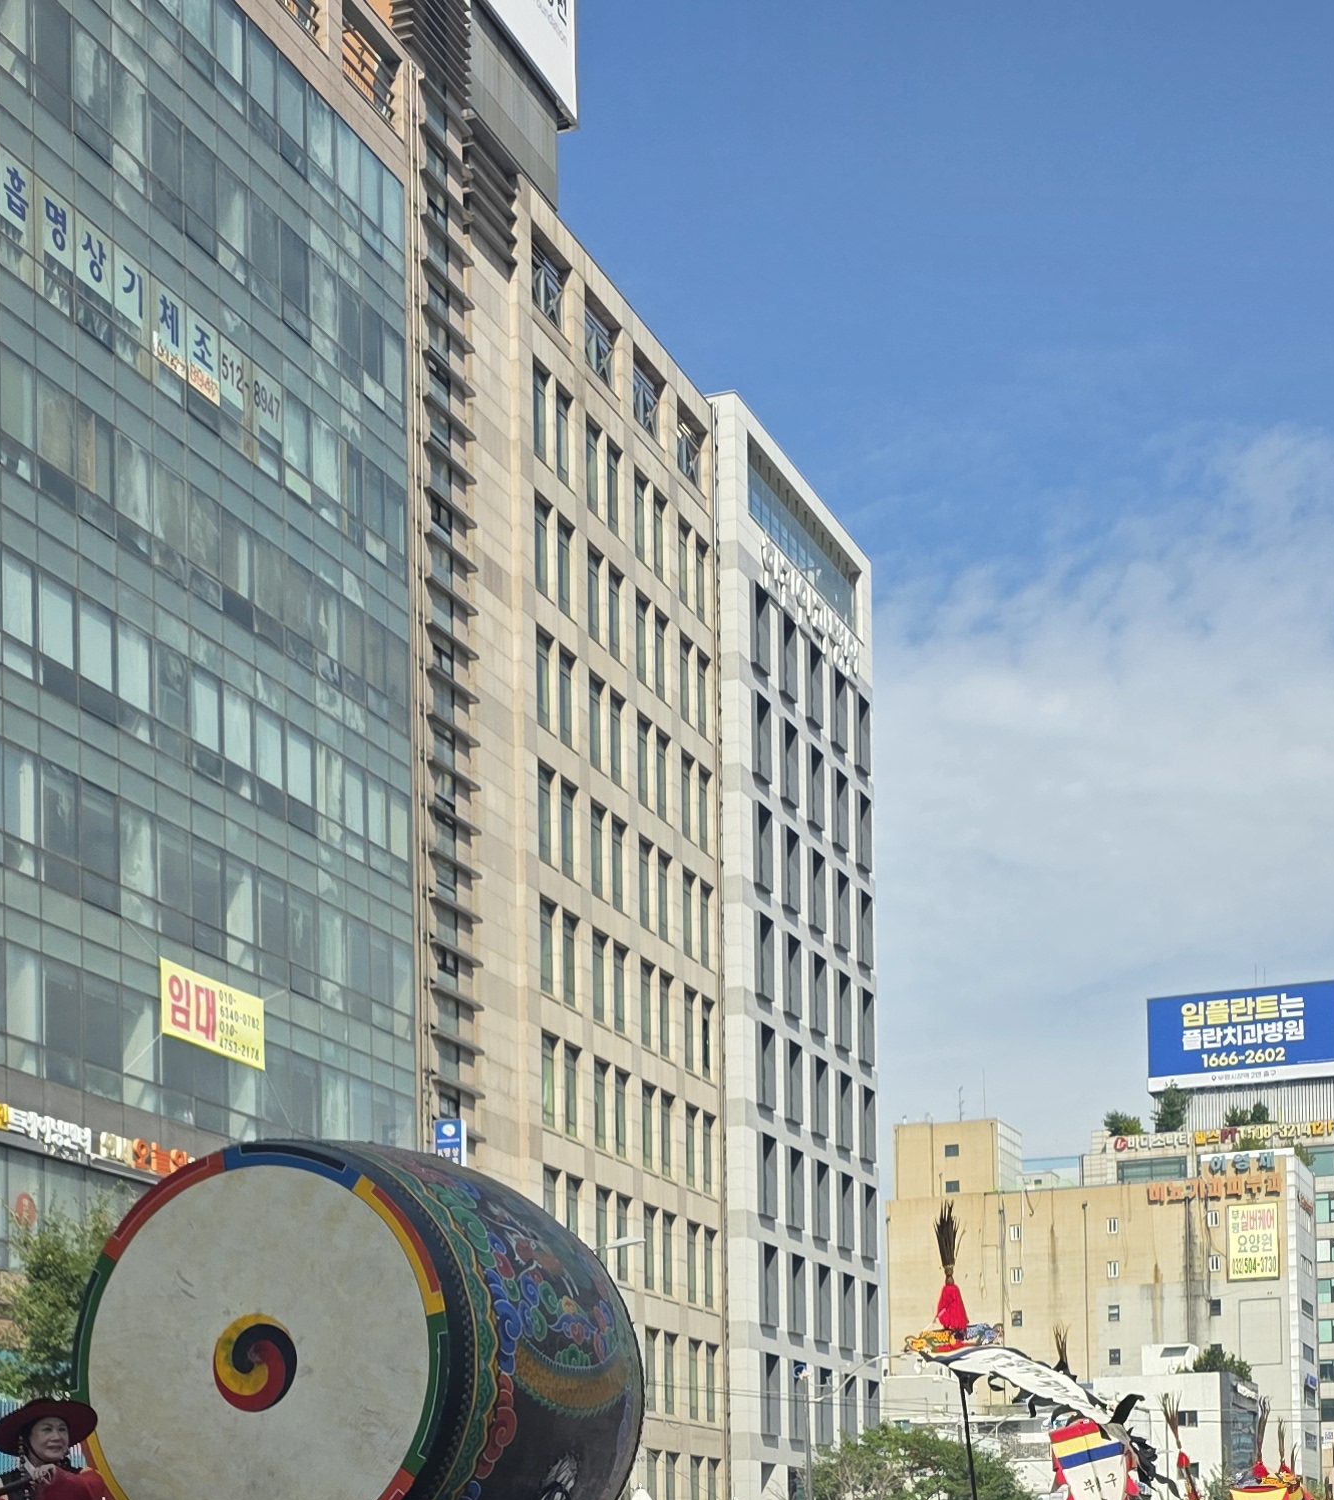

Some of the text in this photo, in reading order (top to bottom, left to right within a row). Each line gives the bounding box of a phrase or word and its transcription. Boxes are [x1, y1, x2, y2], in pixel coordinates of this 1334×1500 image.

[168, 974, 216, 1043] 임대
[1181, 993, 1304, 1027] 임플란트는
[1182, 1019, 1304, 1051] 플란치과병원
[1201, 1047, 1286, 1068] 1666-2602
[1240, 1208, 1275, 1232] 실버케어
[1237, 1233, 1273, 1254] 요양원
